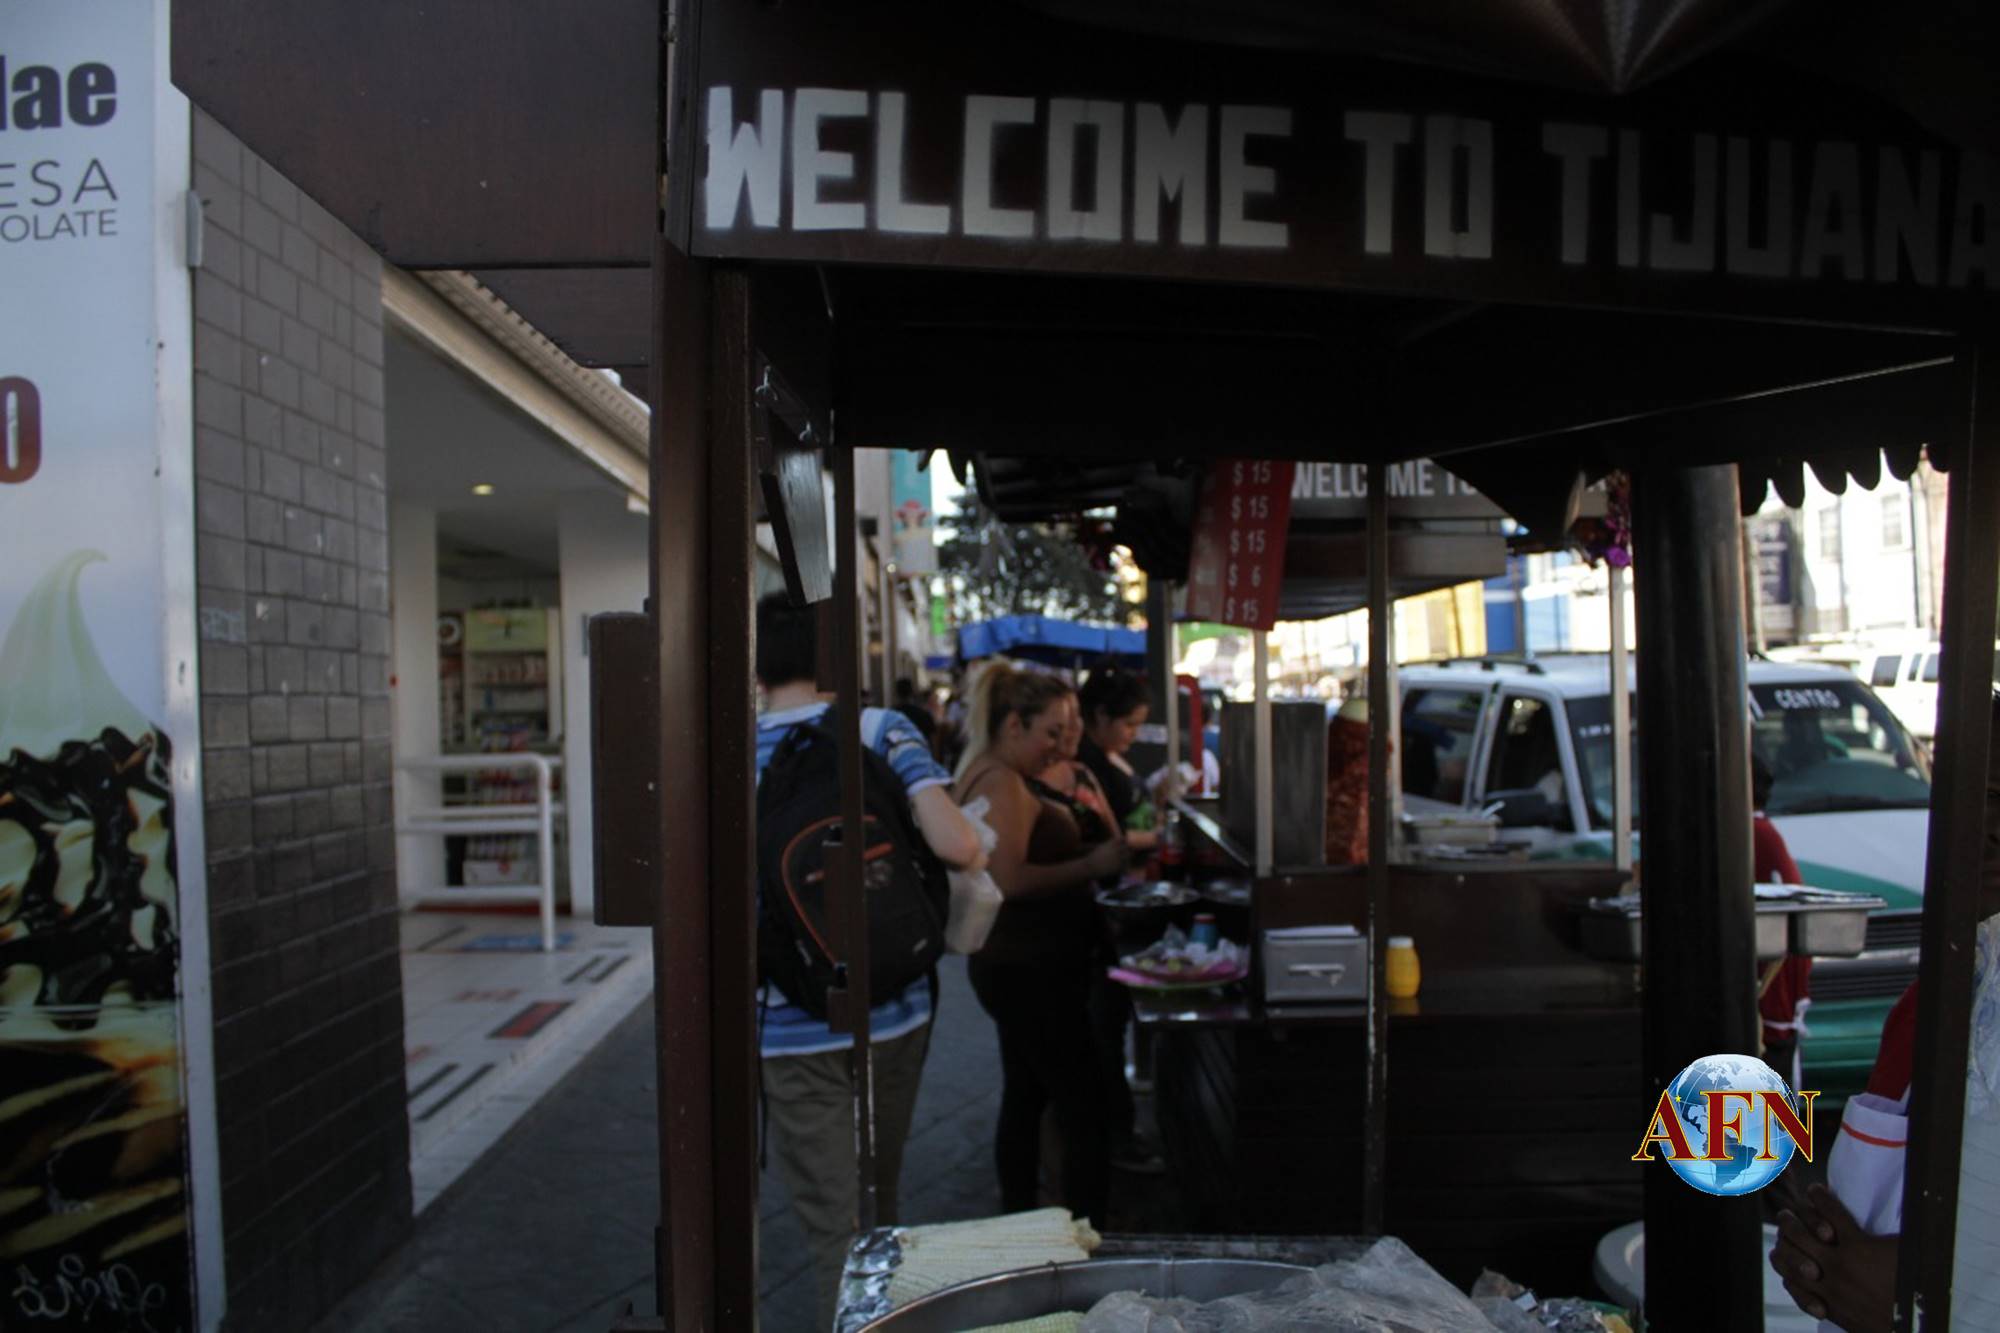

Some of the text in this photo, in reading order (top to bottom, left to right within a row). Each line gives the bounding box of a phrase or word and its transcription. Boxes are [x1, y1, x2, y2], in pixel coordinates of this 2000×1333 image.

[704, 85, 2000, 290] WELCOME TO TIJUANA
[0, 208, 118, 243] OLATE
[1251, 459, 1273, 485] 15
[1290, 457, 1435, 498] WELCME
[1249, 495, 1270, 520] 15
[1247, 529, 1266, 554] 15
[1241, 598, 1260, 623] 15
[1774, 689, 1840, 709] CENTRO
